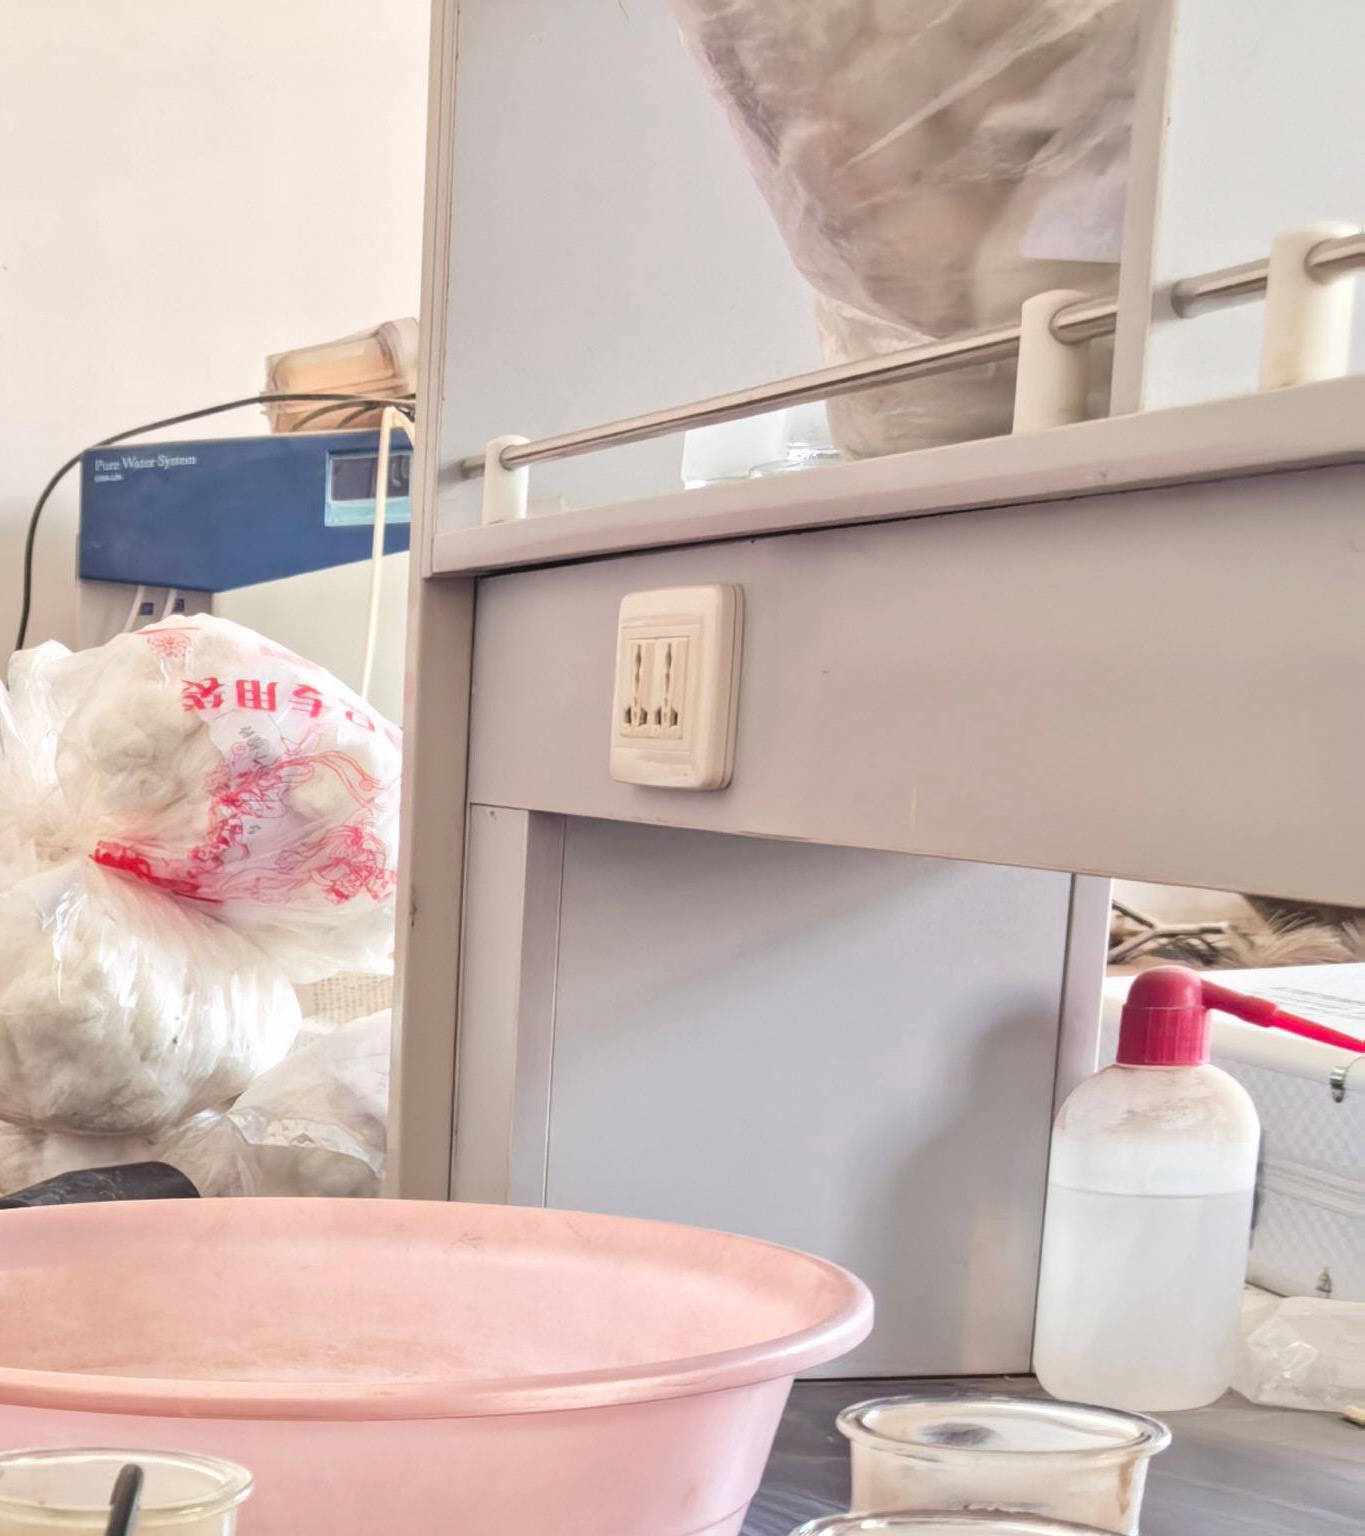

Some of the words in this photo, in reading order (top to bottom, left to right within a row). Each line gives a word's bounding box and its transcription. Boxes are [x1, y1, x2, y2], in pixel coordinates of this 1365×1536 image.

[95, 457, 121, 473] Pure
[122, 455, 157, 471] Water
[156, 453, 197, 471] System
